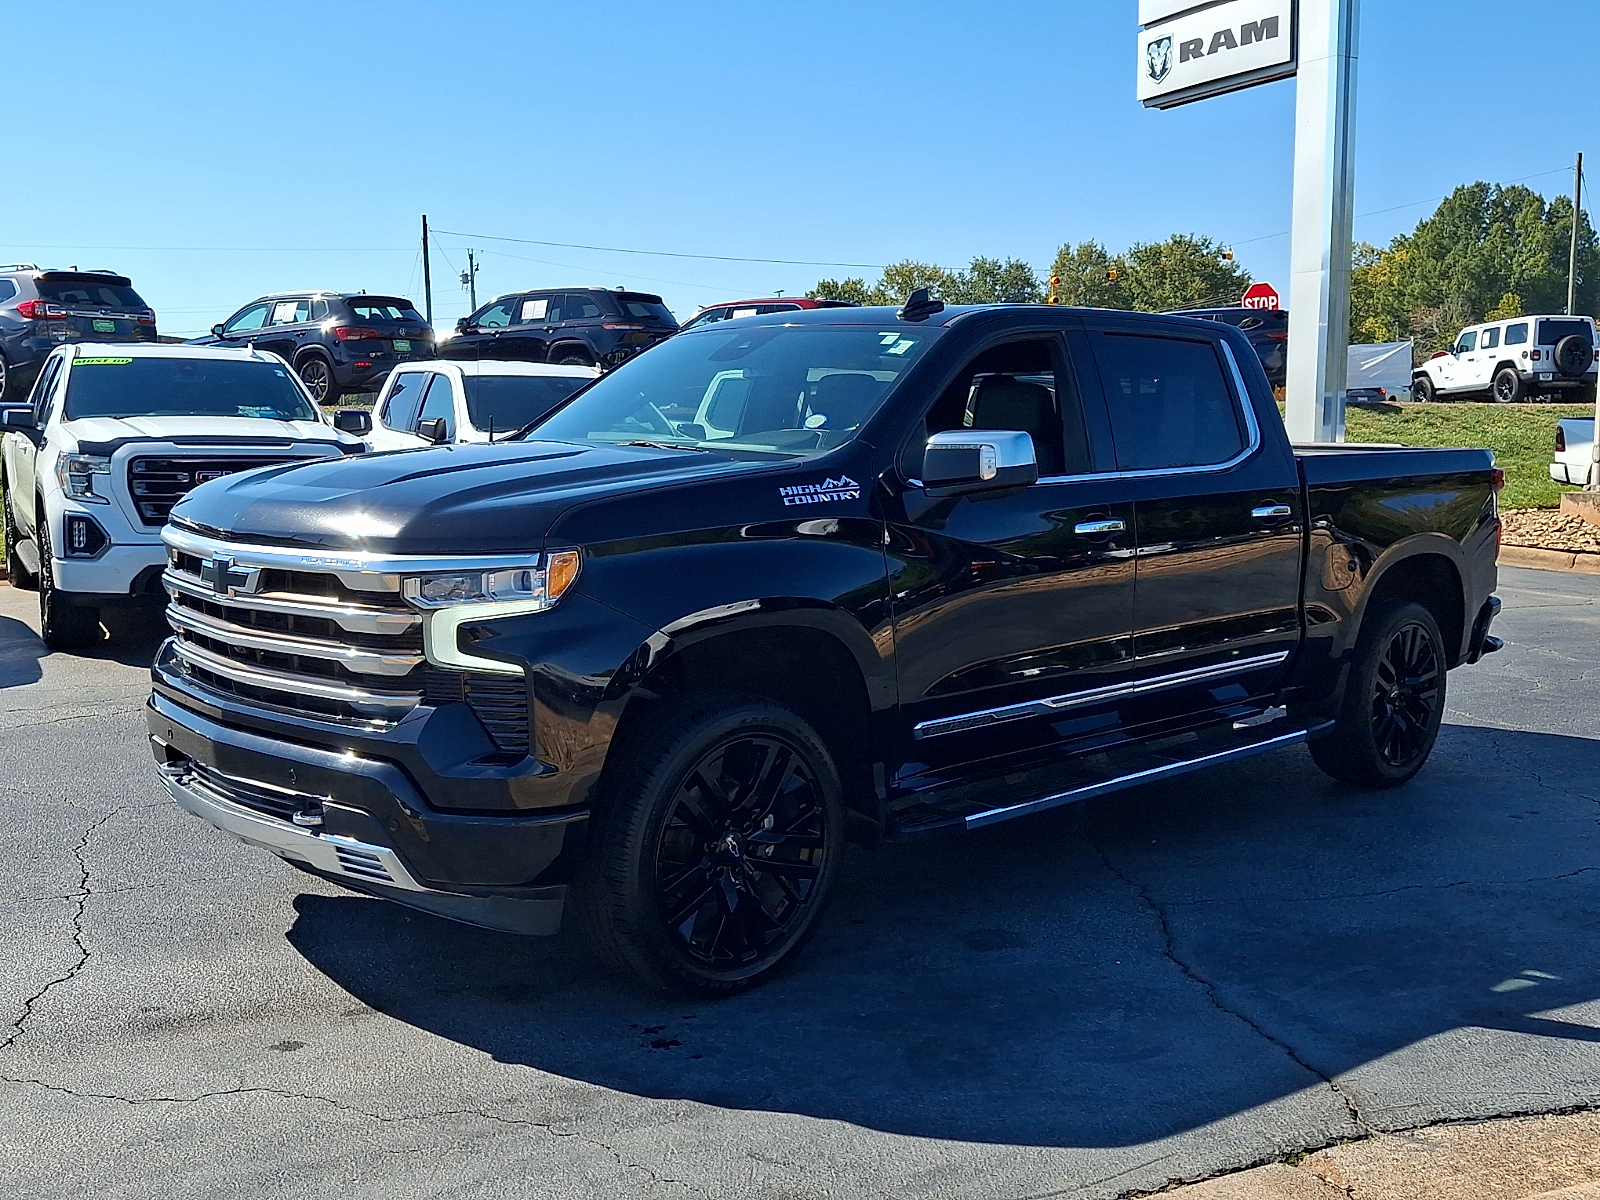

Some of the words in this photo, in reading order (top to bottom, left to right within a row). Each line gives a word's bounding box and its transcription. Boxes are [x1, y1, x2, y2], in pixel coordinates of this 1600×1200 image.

[1179, 15, 1279, 64] RAM
[1245, 295, 1278, 310] STOP
[779, 484, 821, 496] HIGH
[783, 490, 860, 506] COUNTRY
